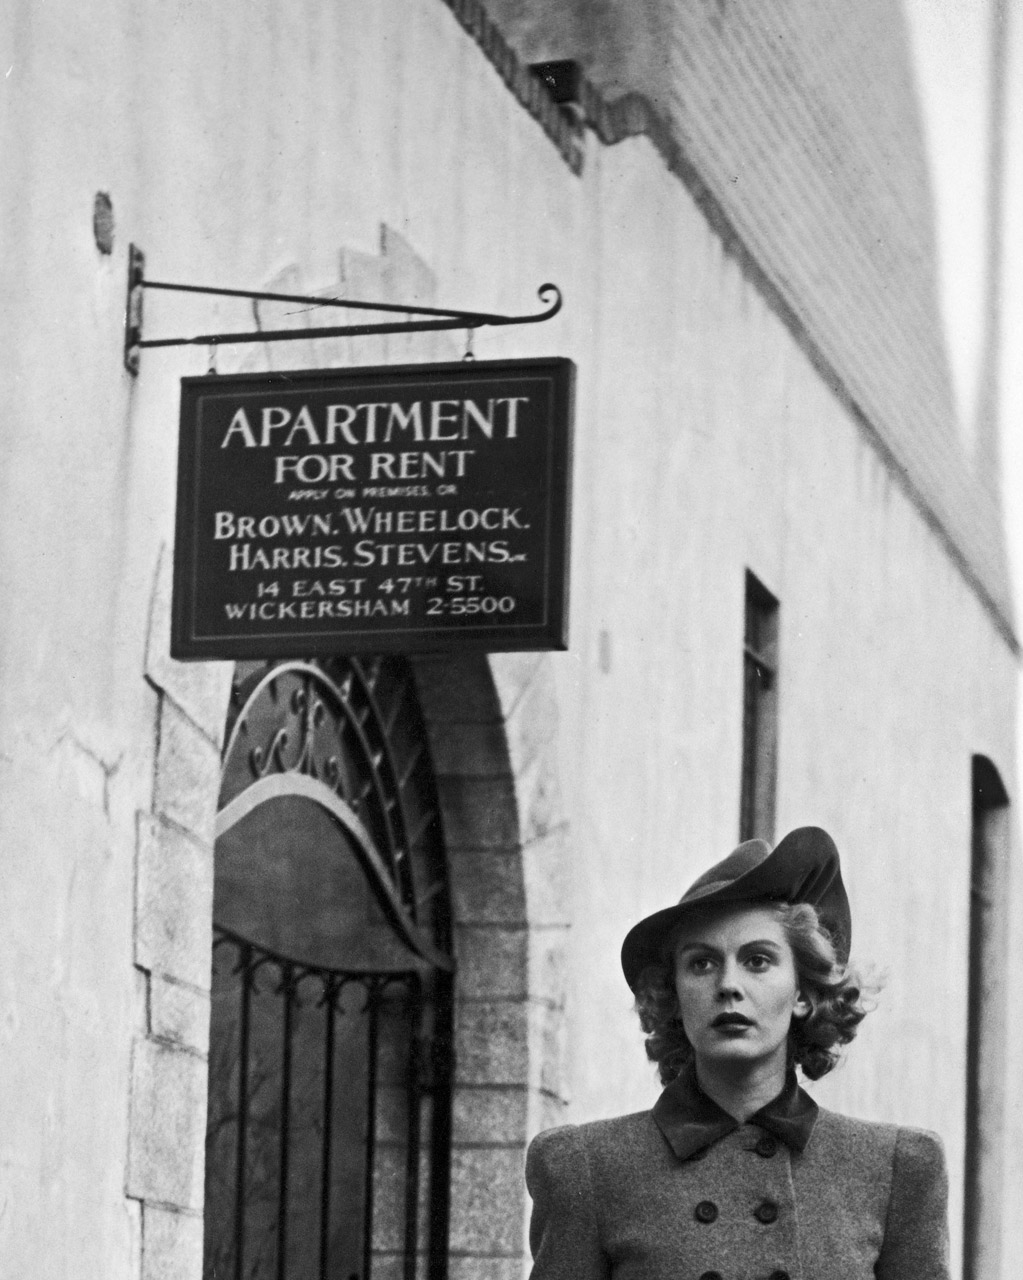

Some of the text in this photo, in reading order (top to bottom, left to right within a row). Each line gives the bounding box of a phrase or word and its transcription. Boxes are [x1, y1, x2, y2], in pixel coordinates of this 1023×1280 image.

[220, 397, 529, 448] APARTMENT
[274, 450, 475, 484] FOR RENT
[288, 489, 329, 500] APPLY
[335, 488, 355, 499] ON
[437, 485, 456, 495] OR
[258, 581, 280, 597] 14
[293, 579, 365, 596] EAST
[225, 597, 515, 620] WICKERSHAM 2-5500
